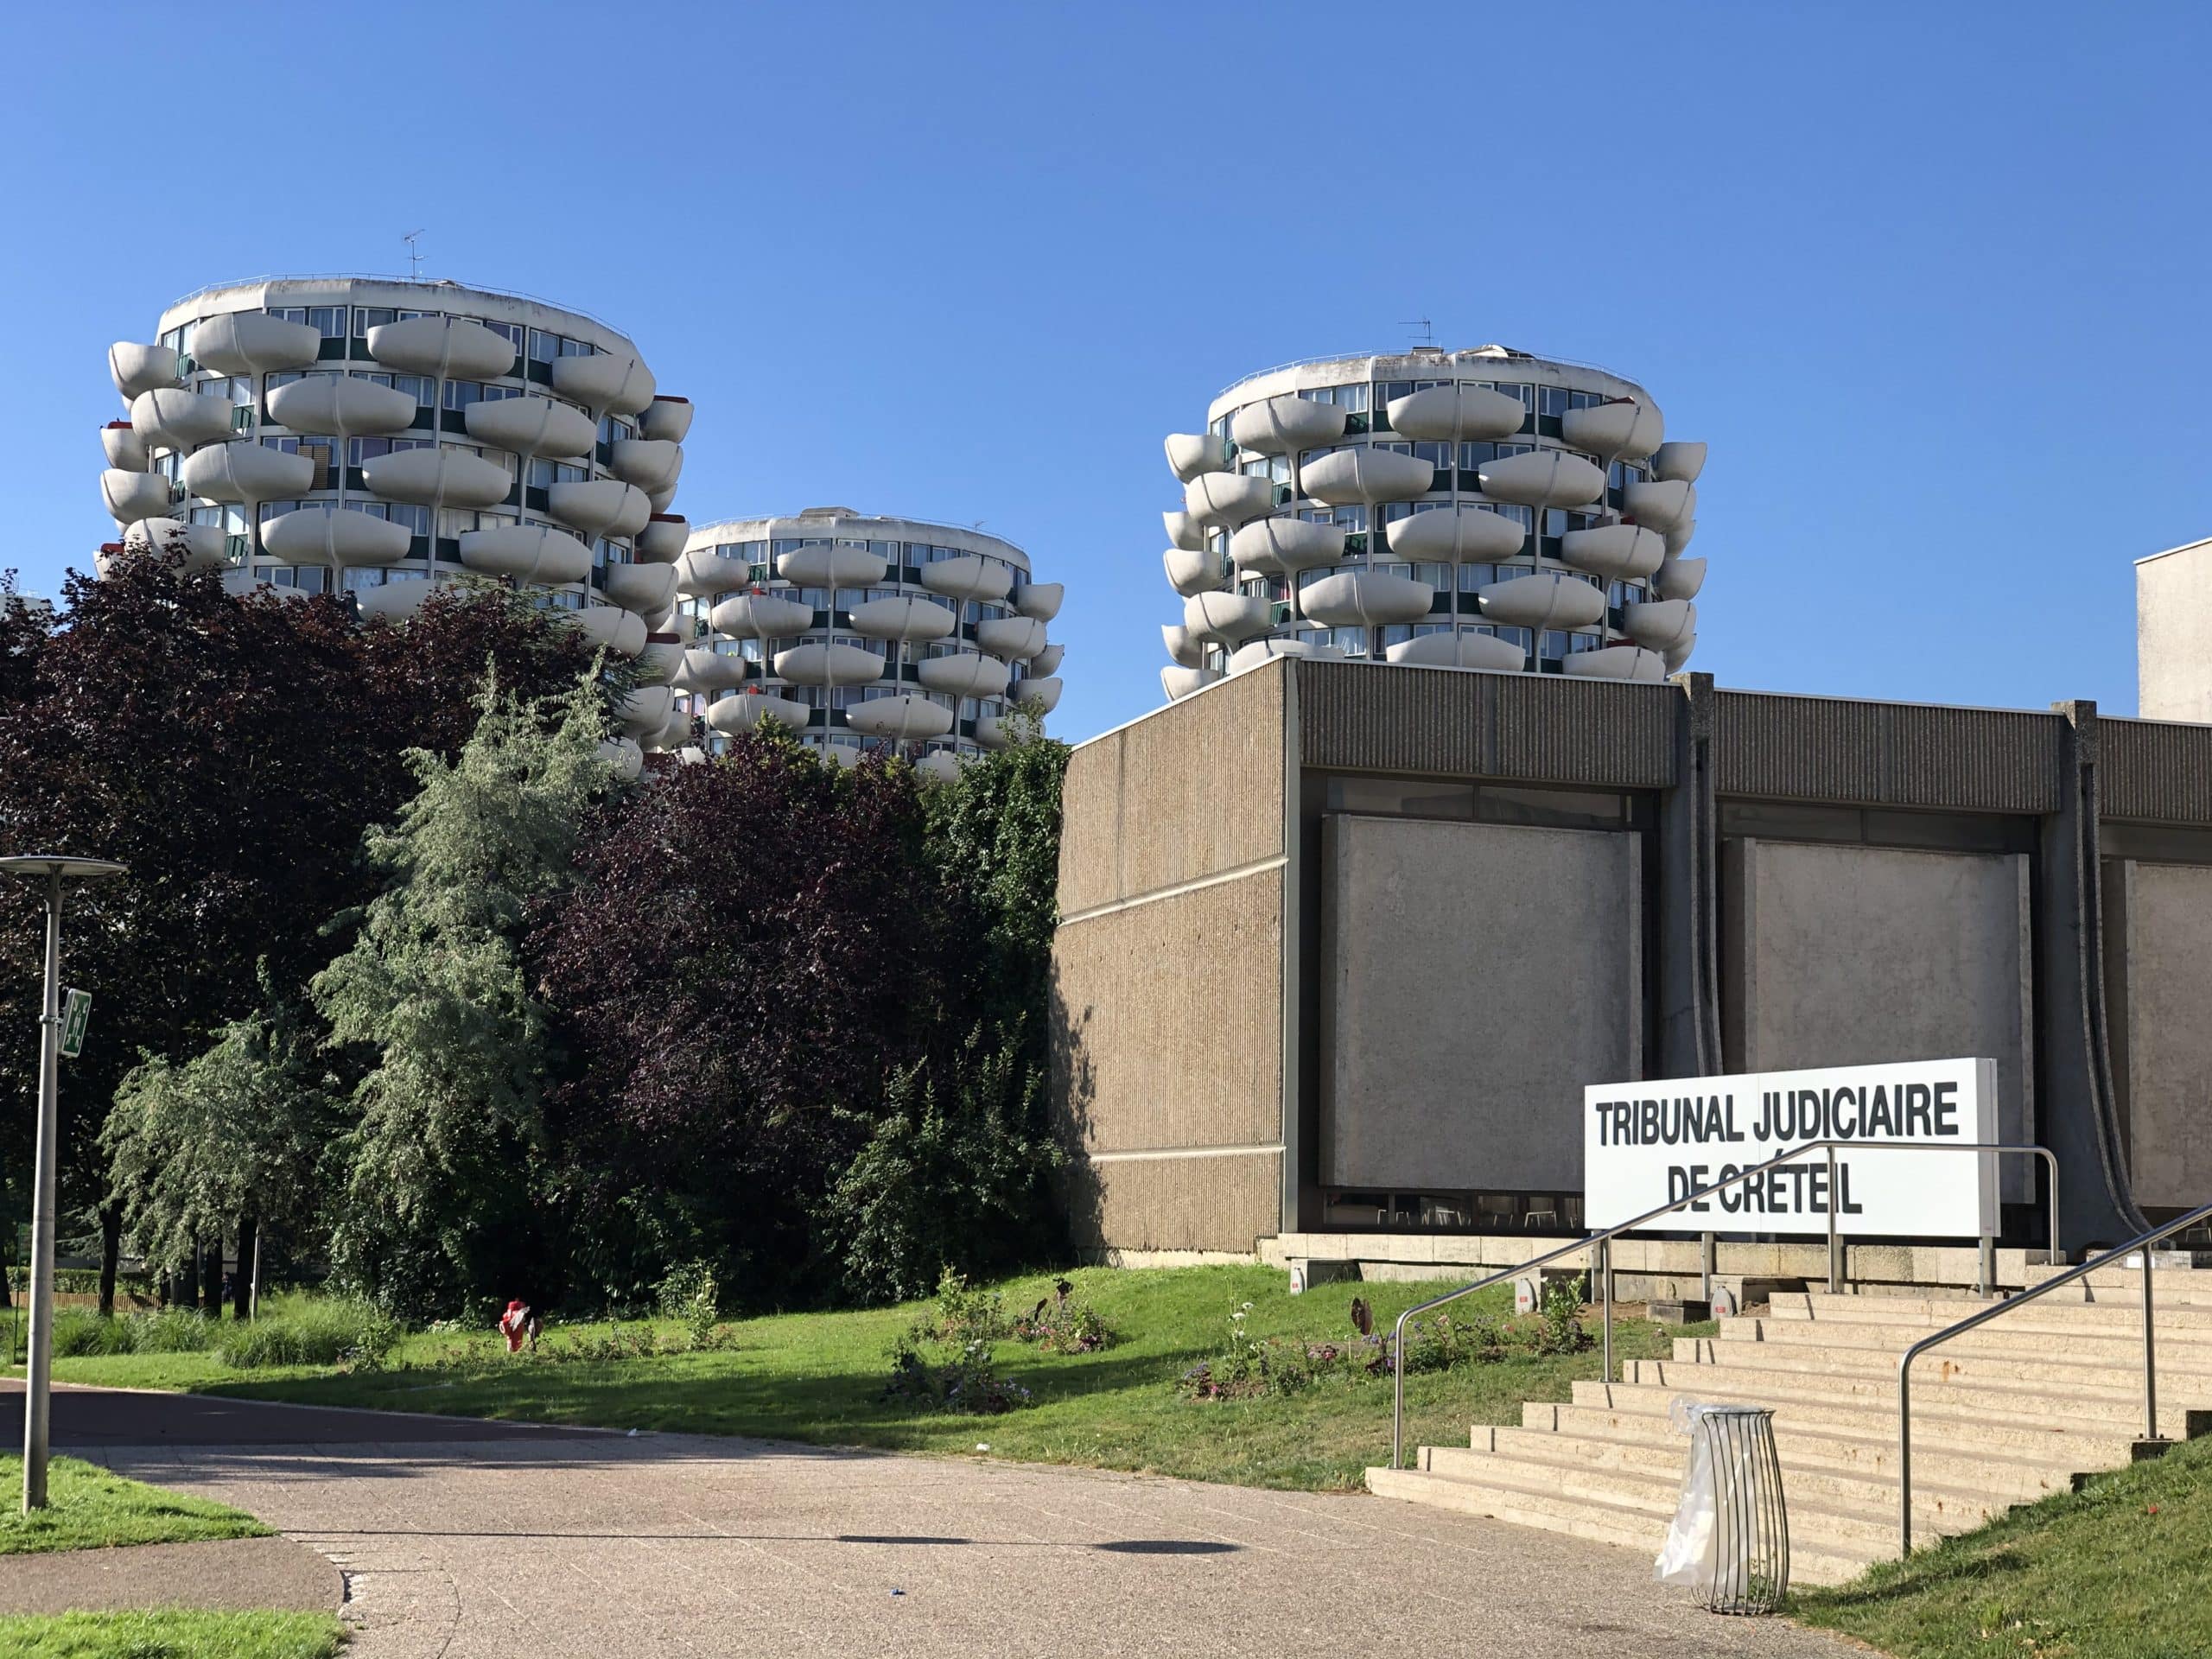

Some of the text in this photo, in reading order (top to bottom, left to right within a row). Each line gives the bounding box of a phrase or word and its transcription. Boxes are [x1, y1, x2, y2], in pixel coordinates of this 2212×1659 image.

[1596, 1082, 1959, 1146] TRIBUNAL JUDICIAIRE
[1669, 1165, 1710, 1211] DE
